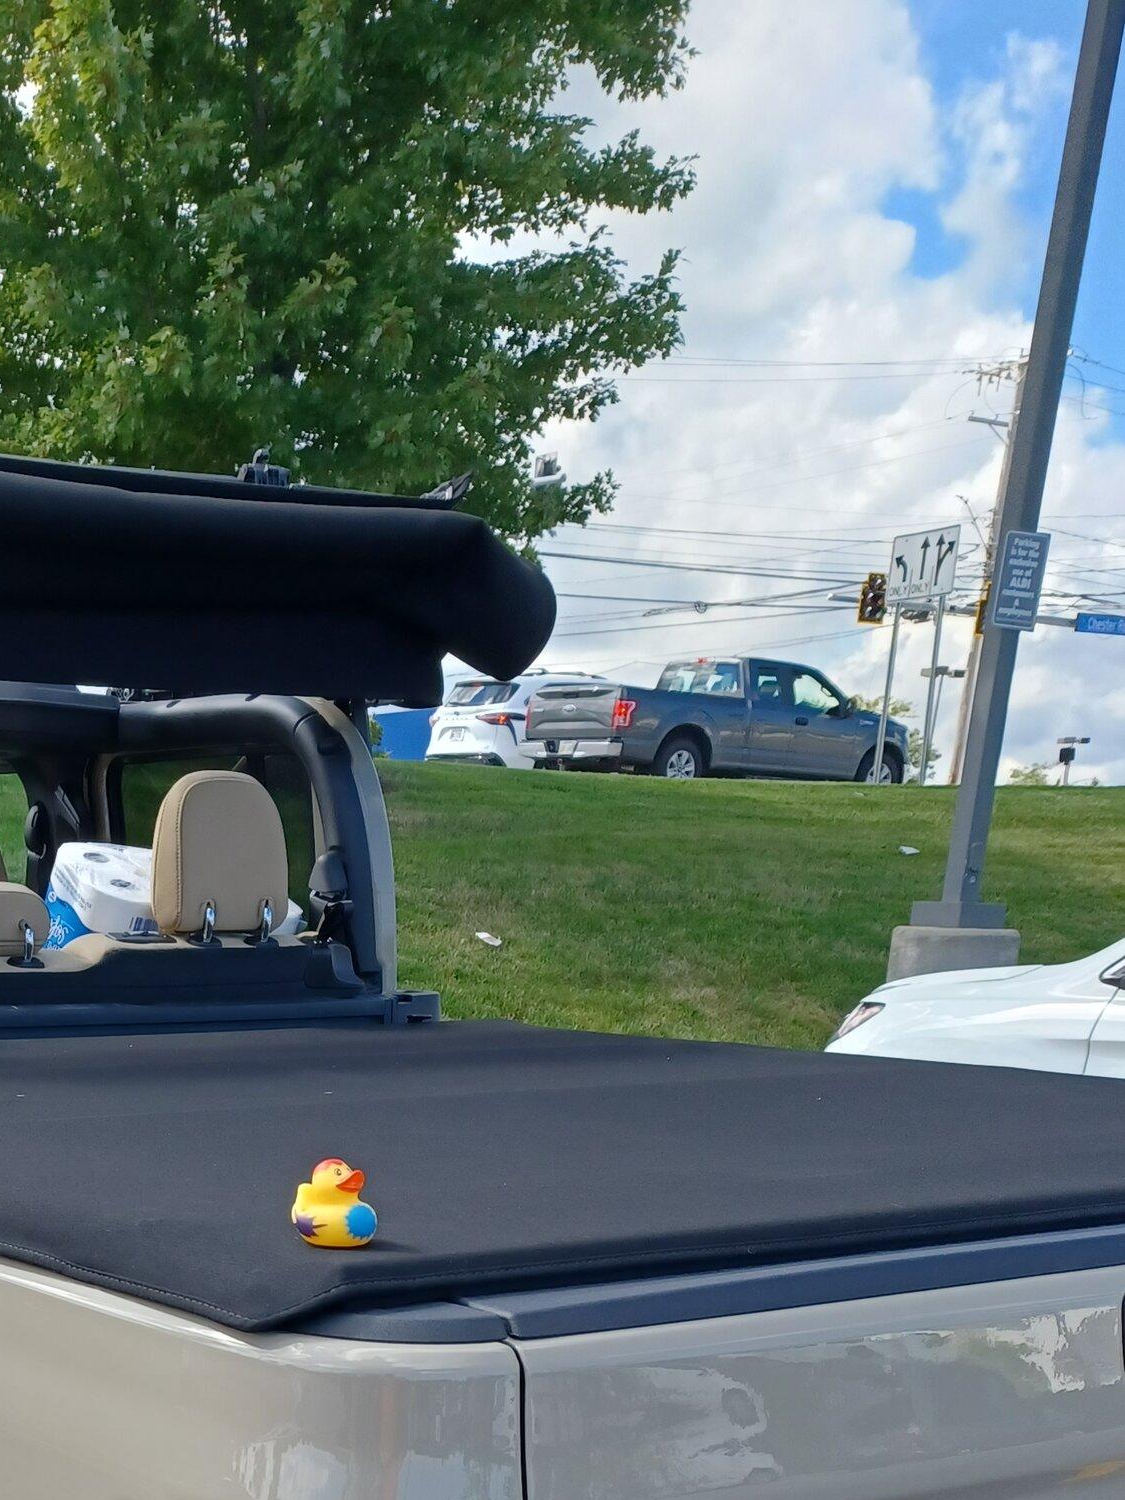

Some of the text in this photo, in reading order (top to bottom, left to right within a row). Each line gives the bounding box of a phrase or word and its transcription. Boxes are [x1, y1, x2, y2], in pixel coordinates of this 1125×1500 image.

[888, 585, 908, 598] ONLY
[911, 582, 928, 594] ONLY
[1088, 616, 1117, 633] Chester
